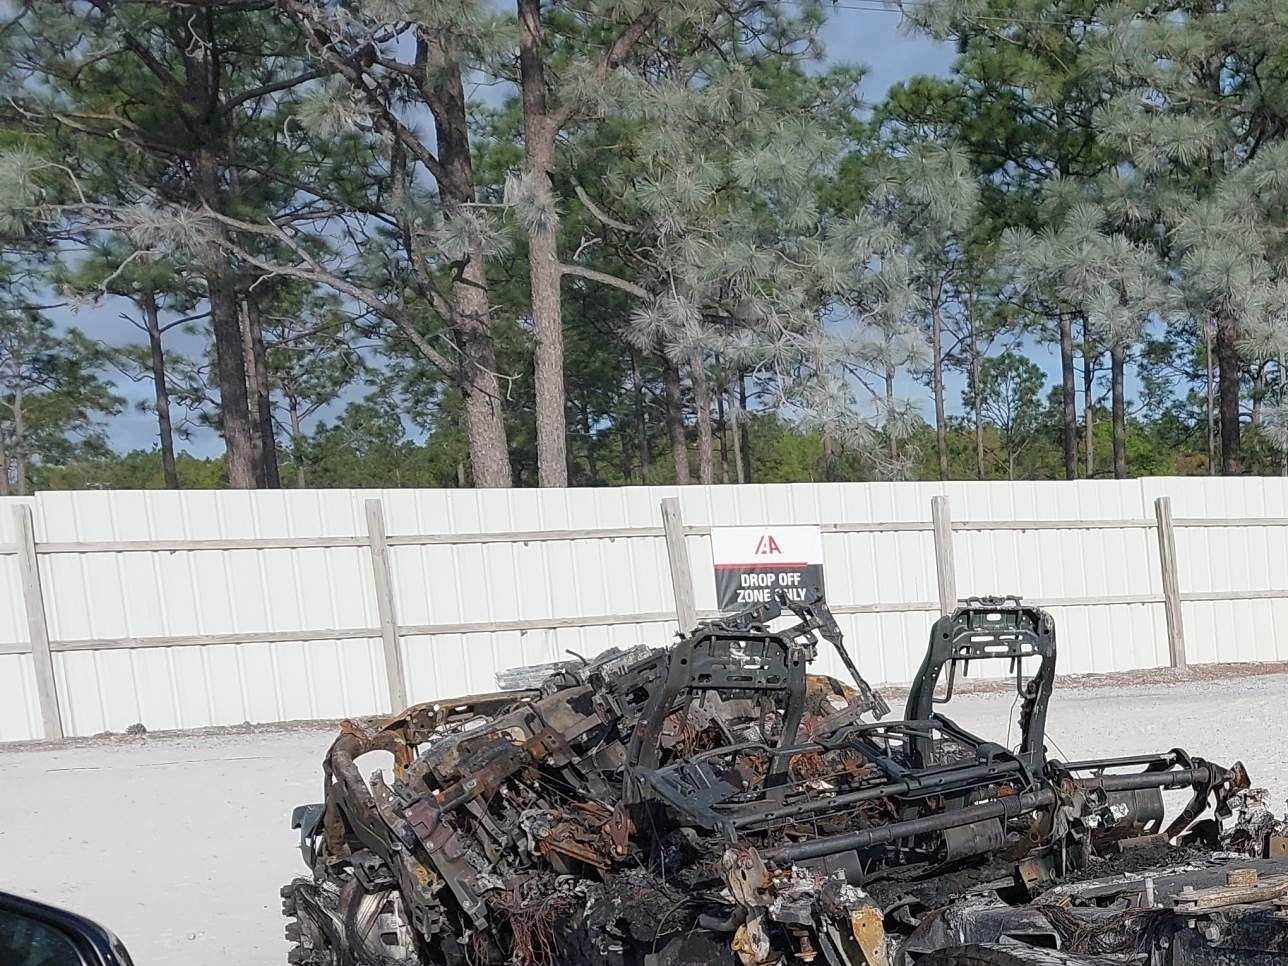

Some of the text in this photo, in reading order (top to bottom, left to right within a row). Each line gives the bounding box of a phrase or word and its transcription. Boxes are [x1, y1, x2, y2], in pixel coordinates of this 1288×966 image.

[741, 572, 801, 587] DROP OFF
[736, 589, 772, 603] ZONE
